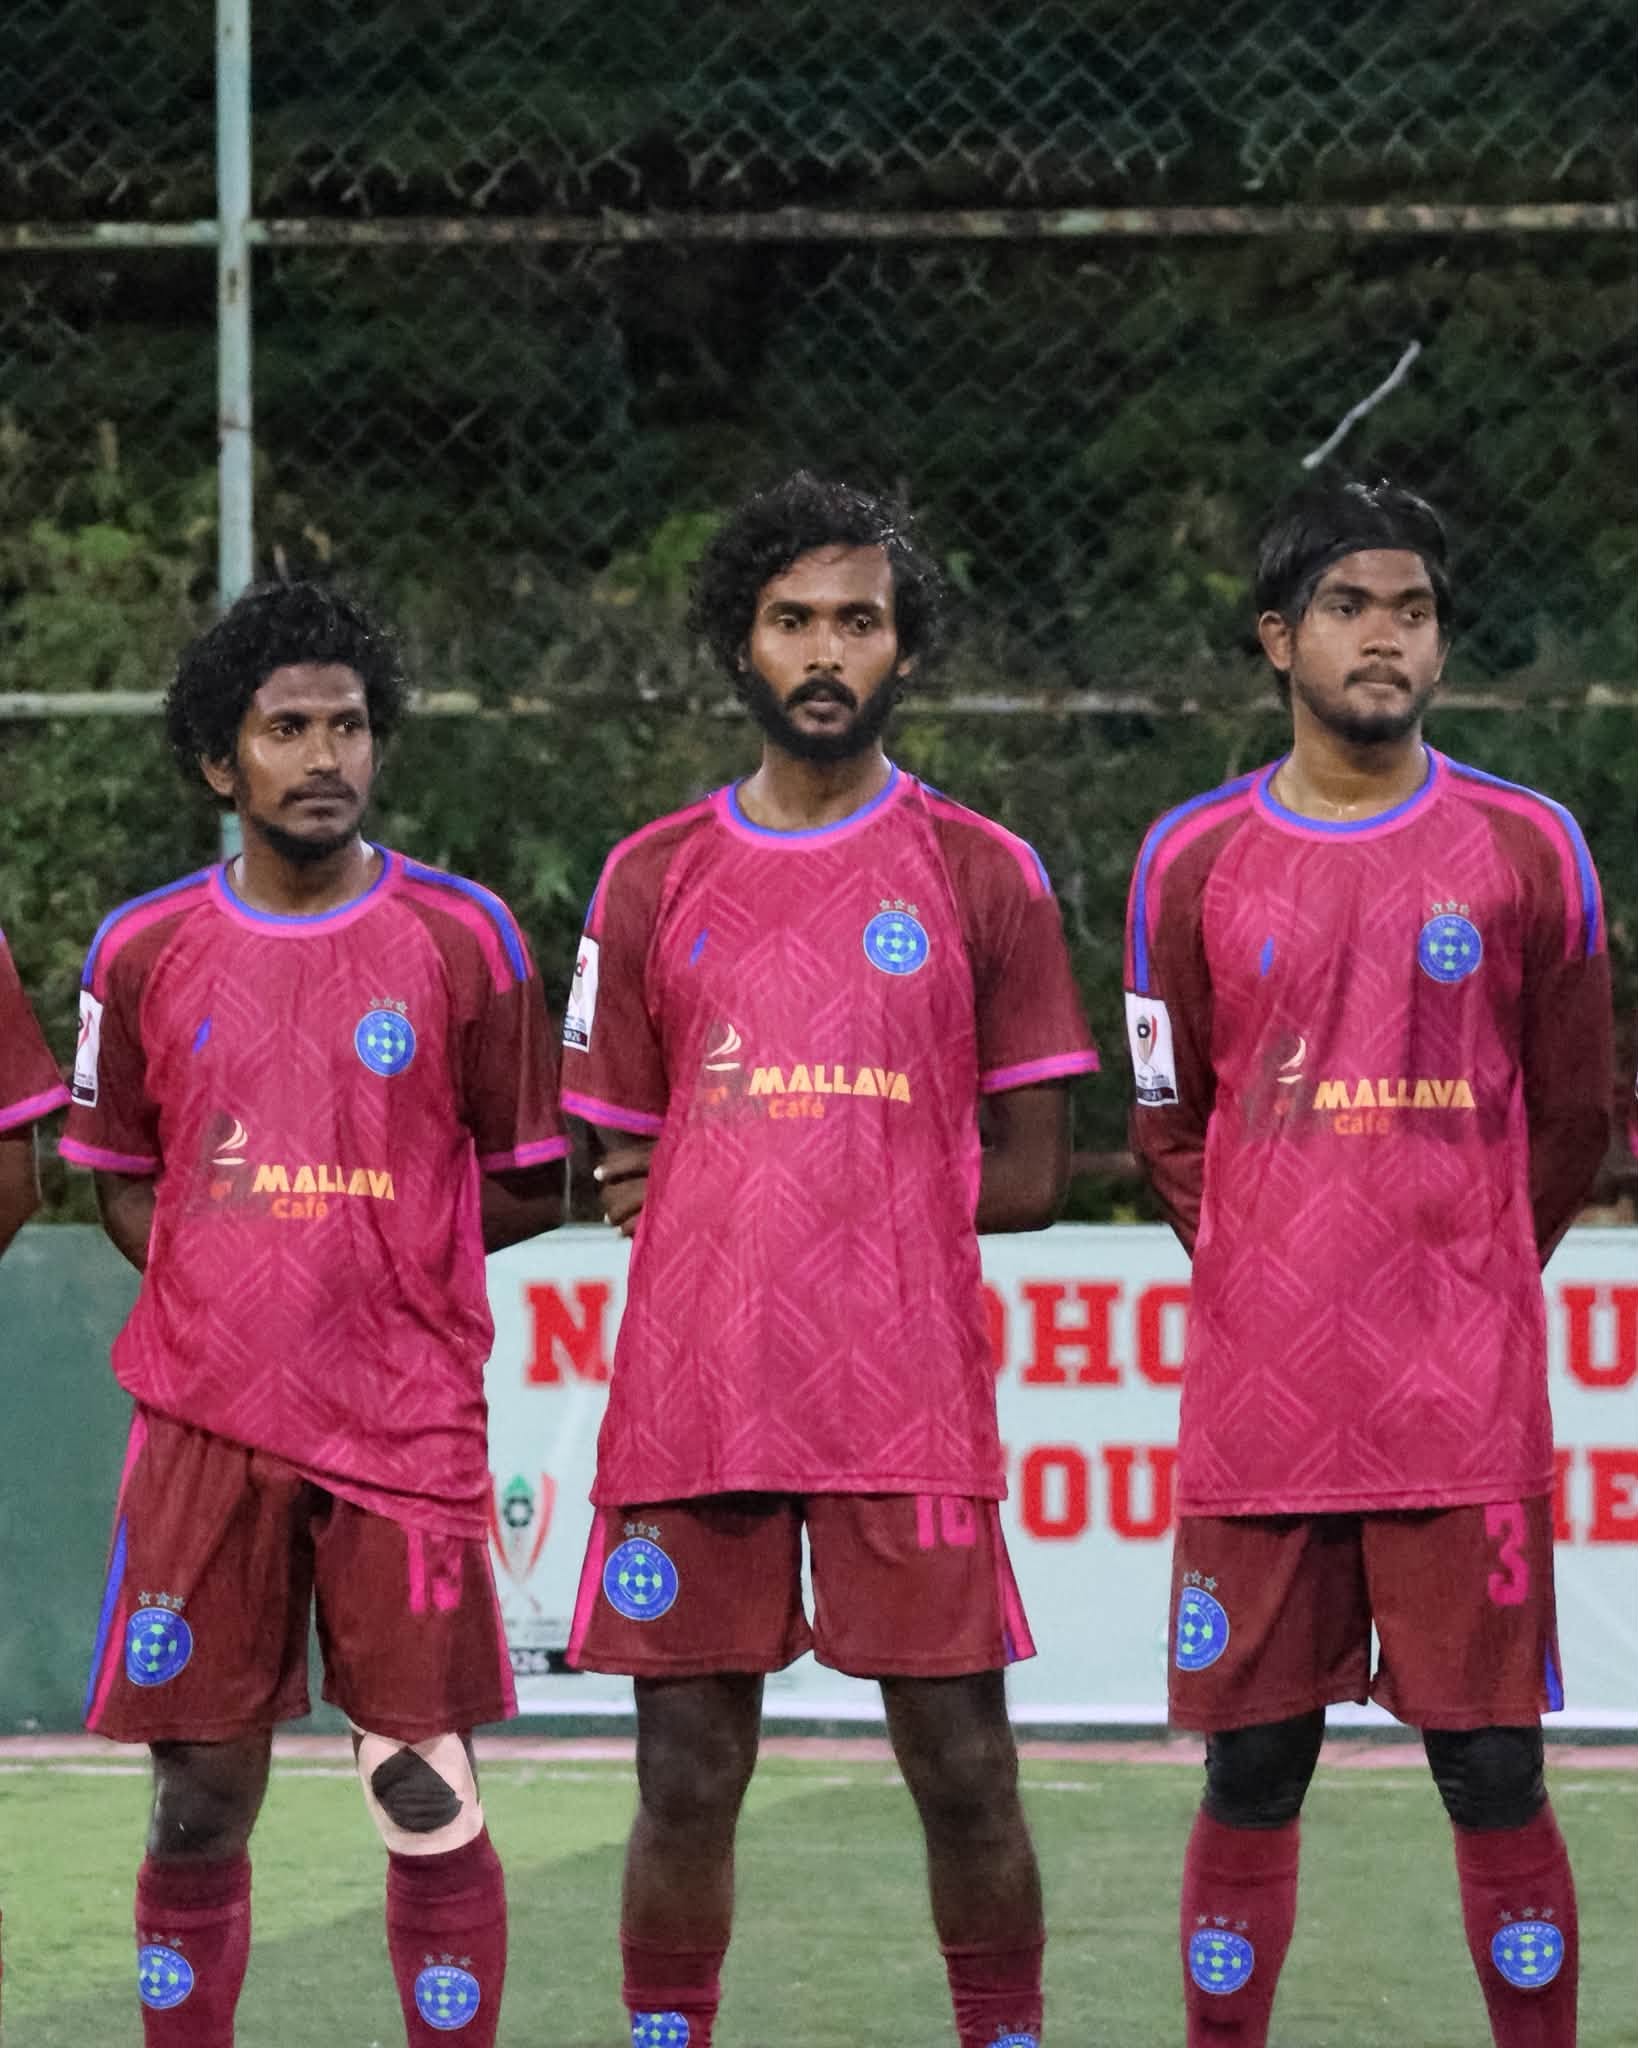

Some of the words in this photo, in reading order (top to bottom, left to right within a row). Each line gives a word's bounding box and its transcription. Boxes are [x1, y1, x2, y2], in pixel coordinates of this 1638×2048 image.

[749, 1064, 911, 1103] MALLAVA
[1312, 1078, 1476, 1110] MALLAVA
[1484, 1501, 1530, 1606] 3
